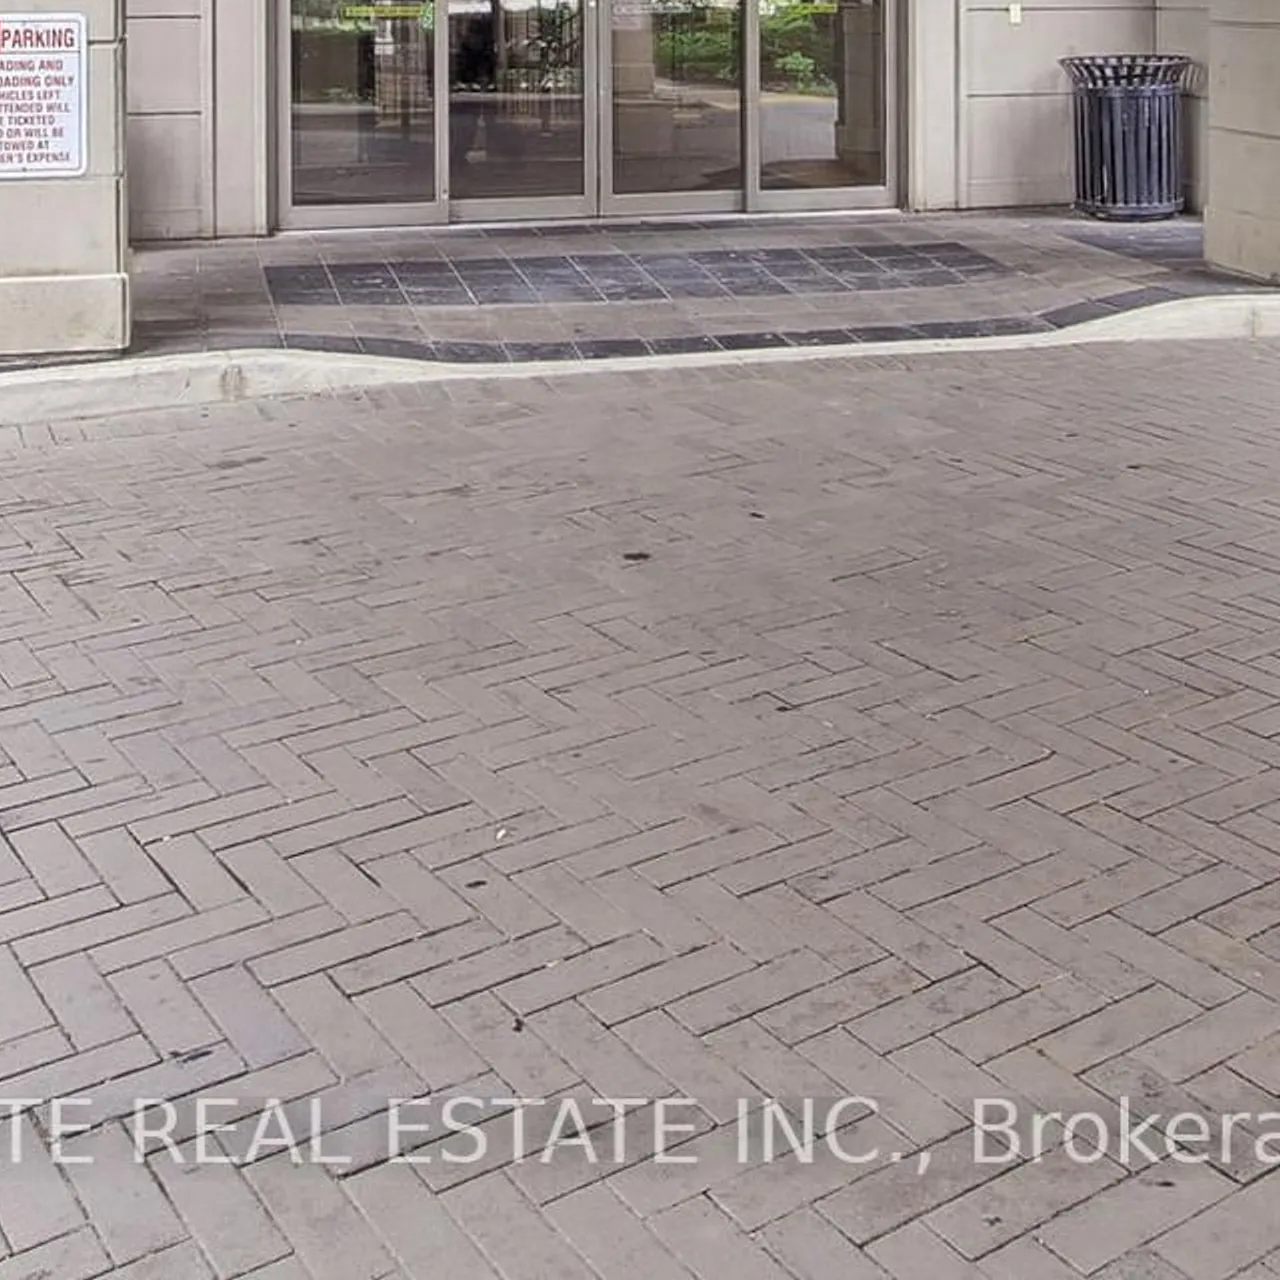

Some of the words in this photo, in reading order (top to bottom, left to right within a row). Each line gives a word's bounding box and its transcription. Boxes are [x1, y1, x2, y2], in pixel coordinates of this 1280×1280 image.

[1, 28, 75, 49] PARKING
[38, 61, 63, 70] AND
[44, 76, 74, 87] ONLY
[37, 91, 60, 100] LEFT
[47, 102, 70, 113] WILL
[8, 116, 55, 125] TICKETED
[6, 129, 21, 138] OR
[24, 128, 48, 138] WILL
[52, 128, 64, 137] BE
[37, 141, 49, 150] AT
[27, 153, 70, 163] EXPENSE
